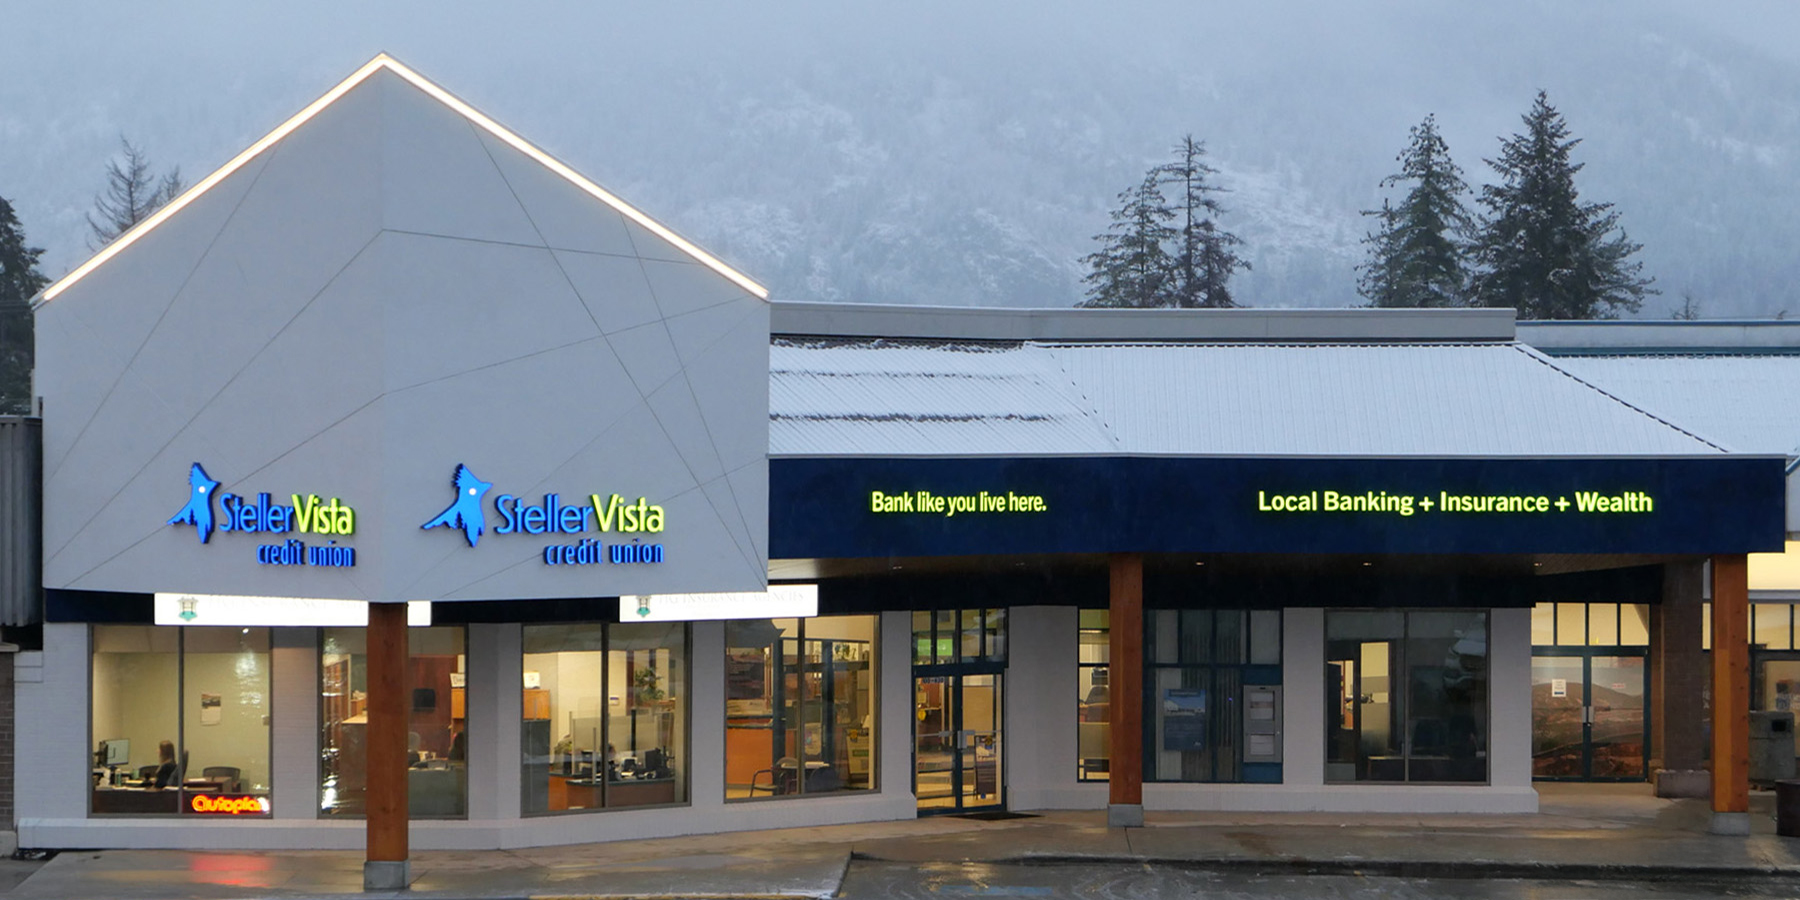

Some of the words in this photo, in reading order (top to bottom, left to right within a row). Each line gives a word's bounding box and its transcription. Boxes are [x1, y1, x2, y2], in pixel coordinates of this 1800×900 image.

[219, 493, 356, 535] StellerVista
[494, 493, 665, 534] StellerVista
[871, 491, 914, 512] Bank
[917, 491, 945, 512] like
[946, 496, 976, 517] you
[979, 491, 1006, 512] live
[1008, 491, 1047, 512] here.
[1258, 491, 1318, 512] Local
[1323, 491, 1415, 516] Banking
[1418, 496, 1435, 512] +
[1440, 491, 1550, 512] Insurance
[1554, 496, 1571, 512] +
[1575, 491, 1653, 512] Wealth
[256, 539, 306, 566] credit
[308, 541, 356, 567] union
[544, 538, 603, 565] credit
[609, 538, 665, 565] union
